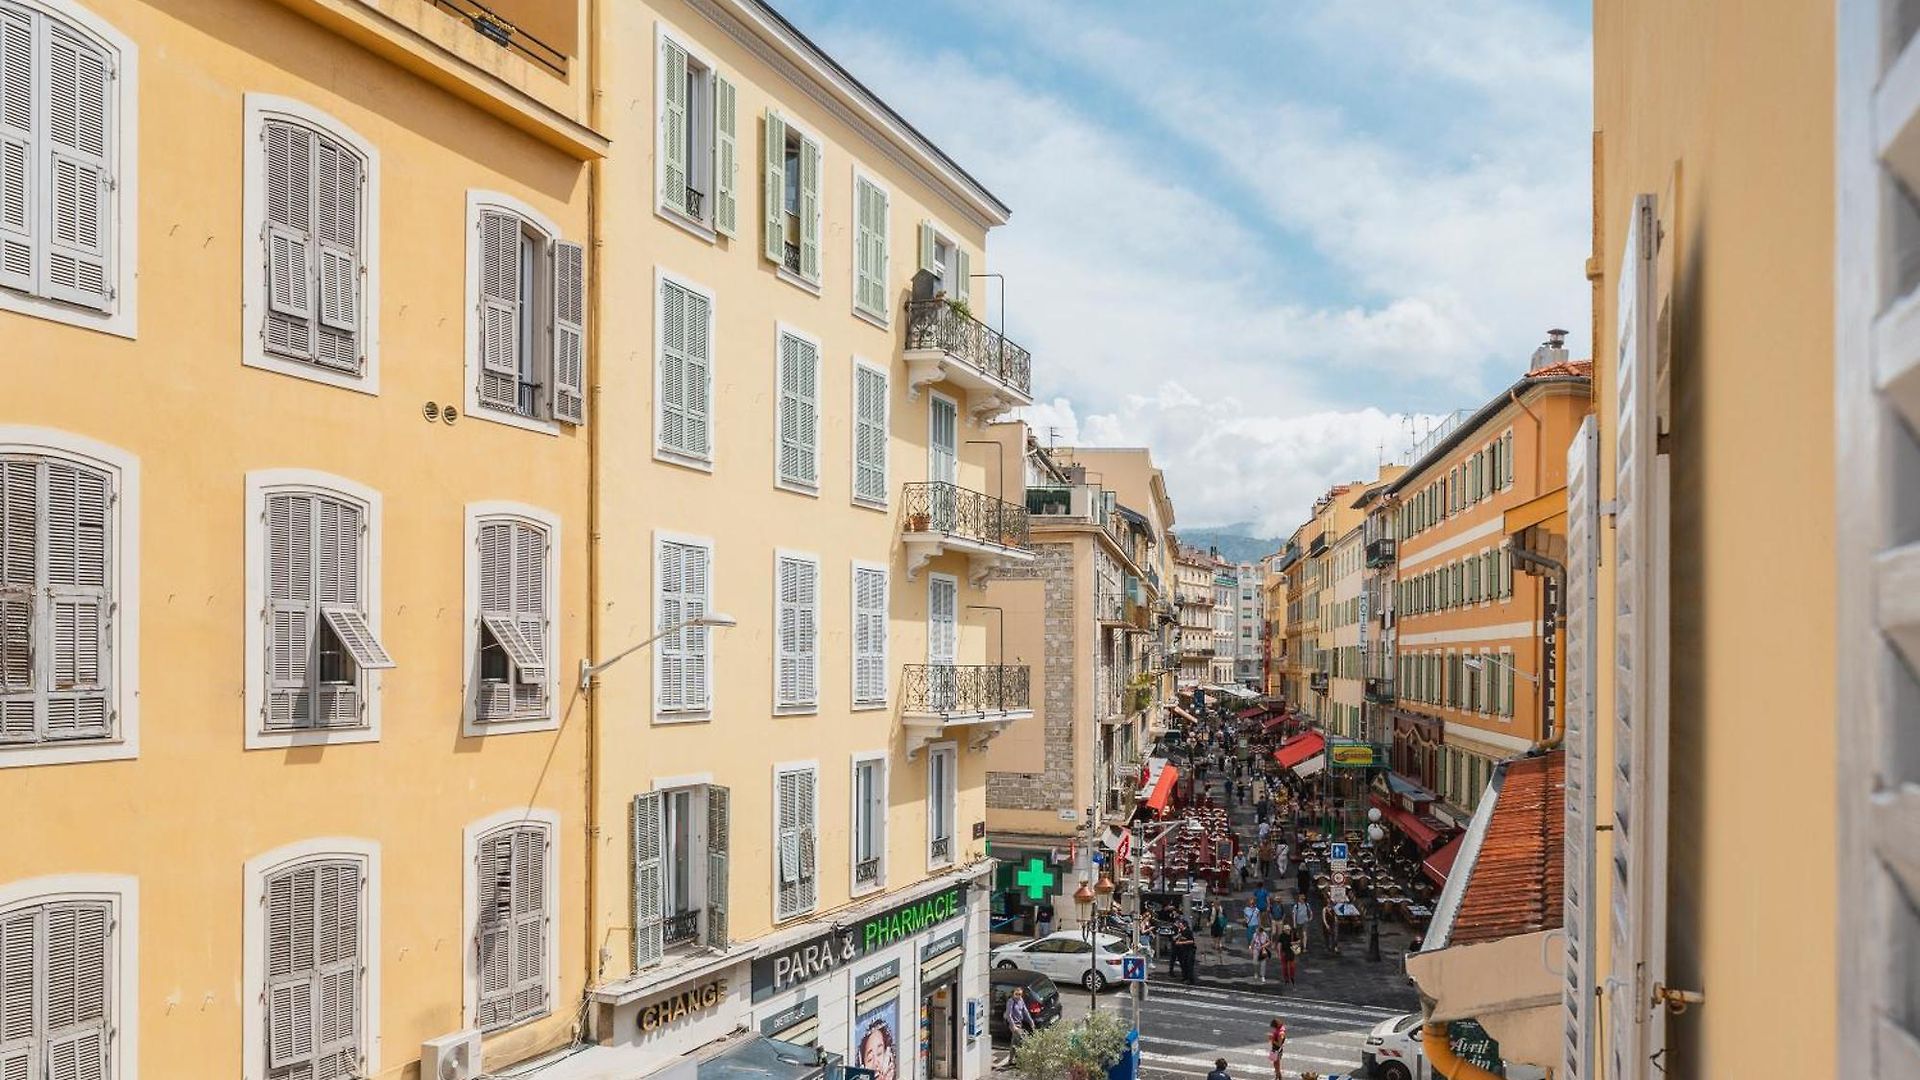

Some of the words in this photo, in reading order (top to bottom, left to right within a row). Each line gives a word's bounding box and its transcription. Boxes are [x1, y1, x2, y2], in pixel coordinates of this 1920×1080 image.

[774, 940, 833, 987] PARA
[843, 932, 856, 960] &
[864, 890, 958, 950] PHARMACIE
[642, 979, 728, 1031] CHANGE
